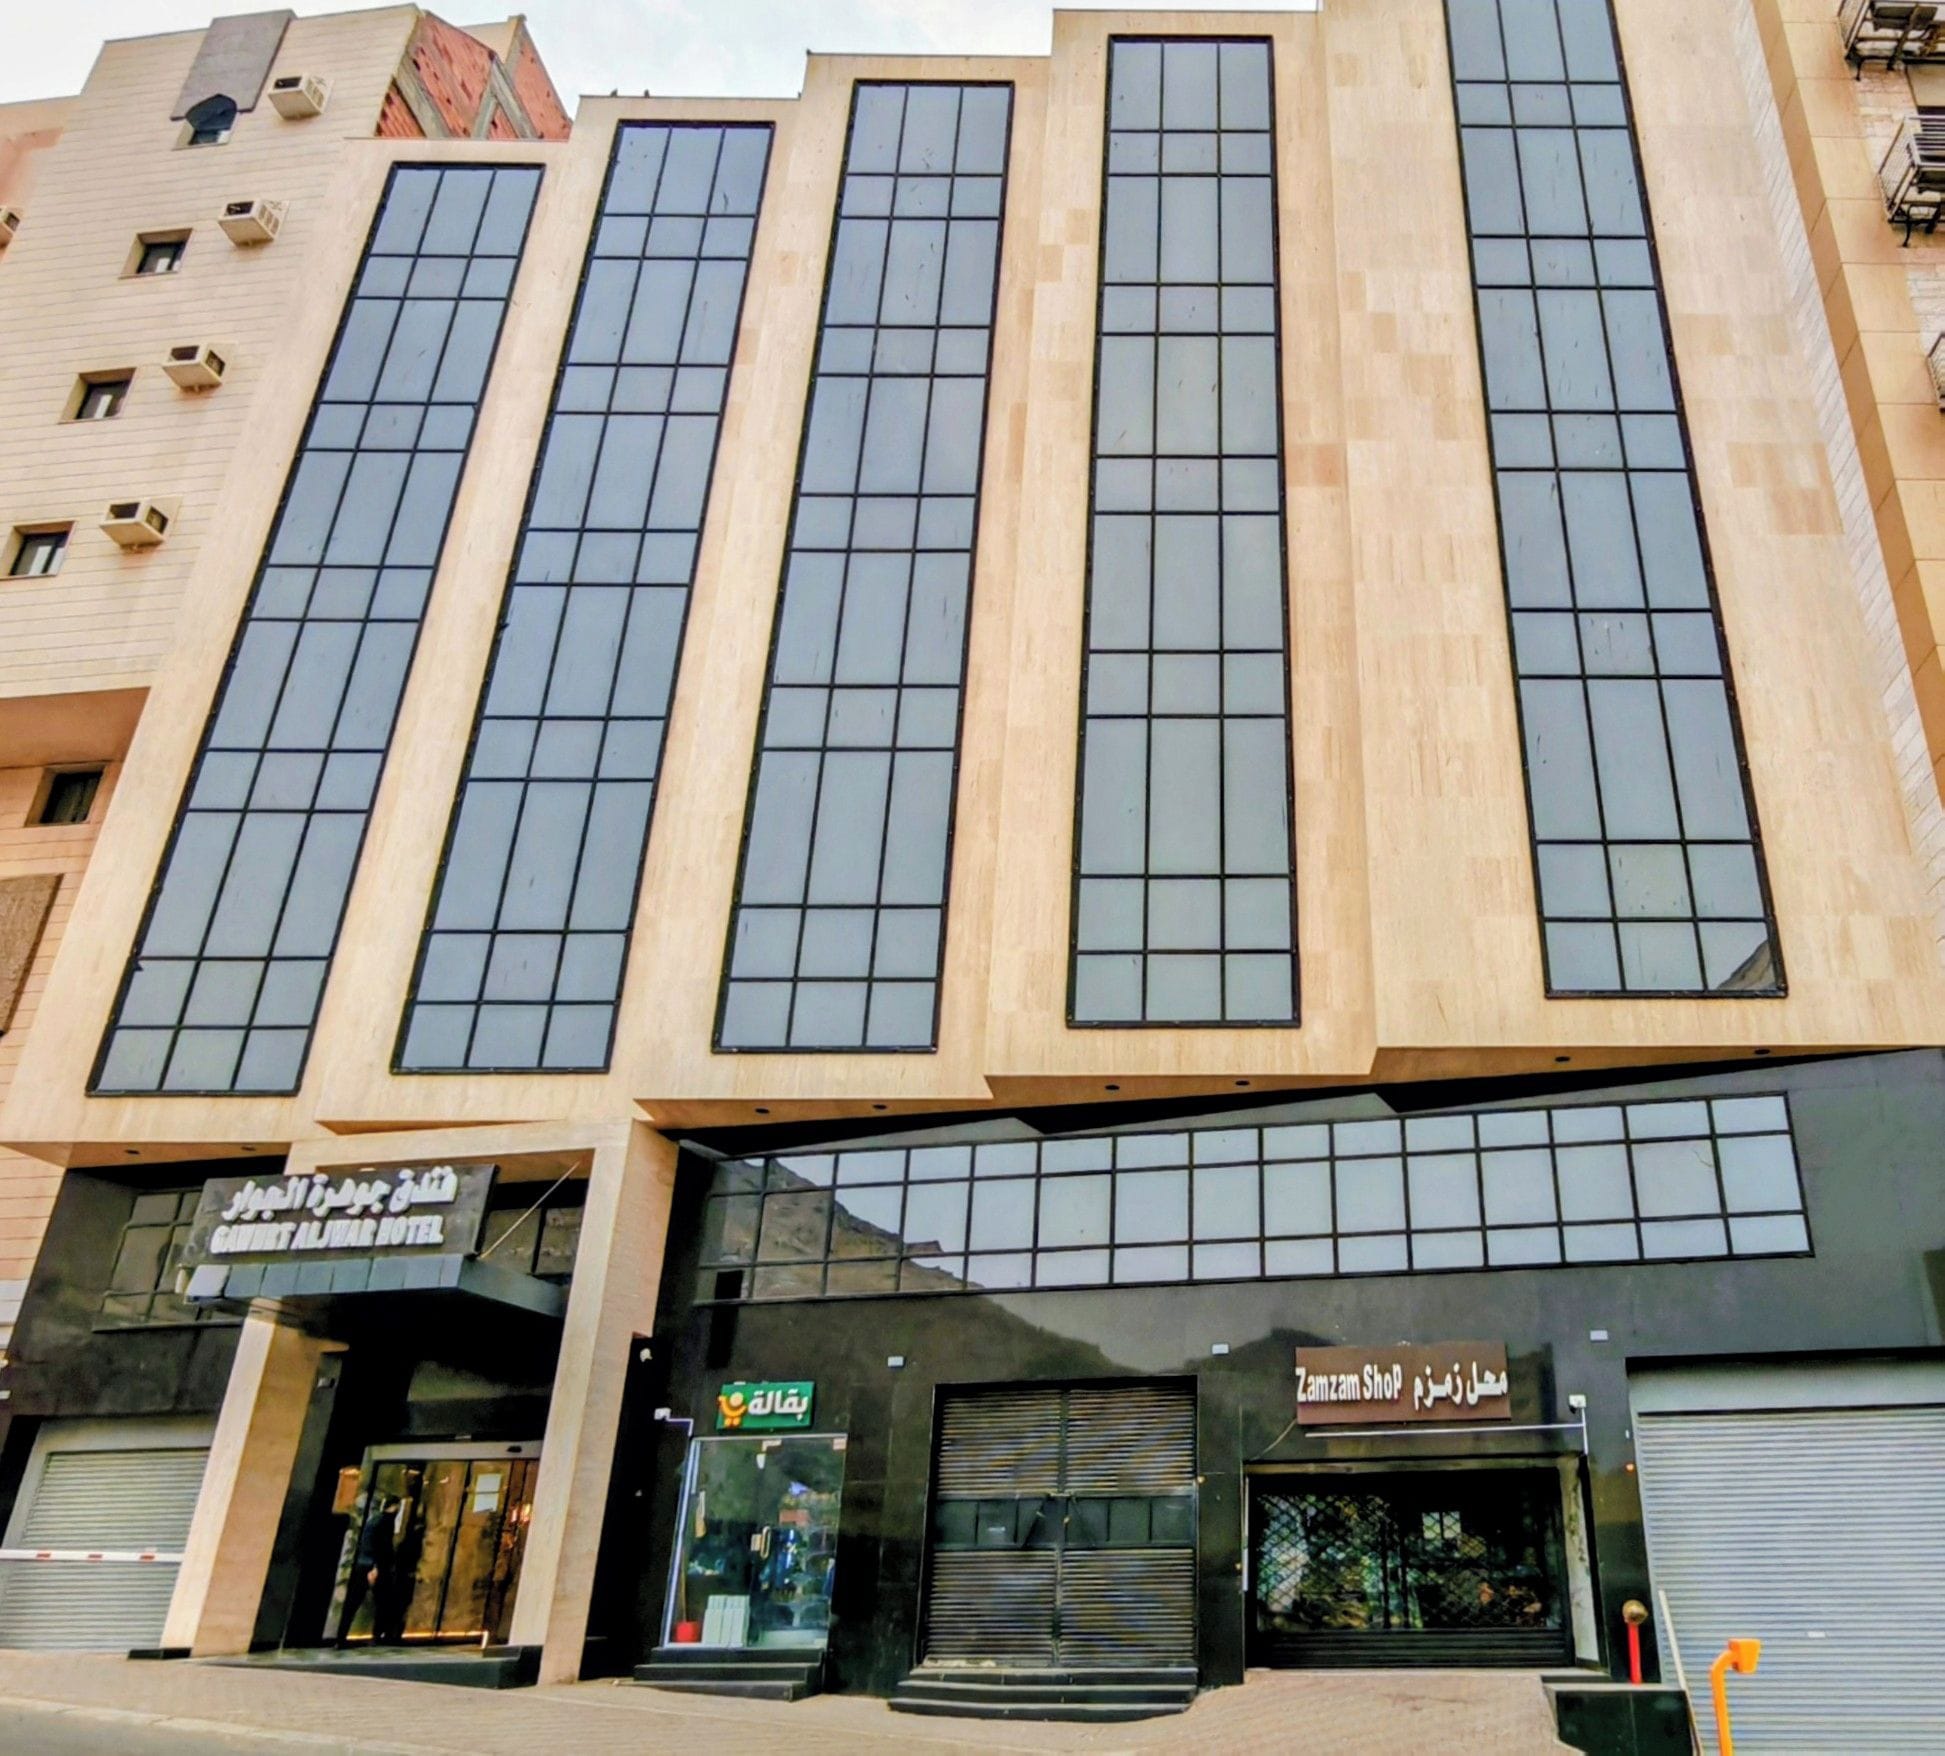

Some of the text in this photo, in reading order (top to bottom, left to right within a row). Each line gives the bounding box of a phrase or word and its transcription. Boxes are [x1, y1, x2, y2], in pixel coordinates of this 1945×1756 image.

[389, 1165, 458, 1213] فندق
[290, 1218, 377, 1250] ALJWAR
[374, 1214, 444, 1246] HOTEL
[1295, 1366, 1361, 1402] Zamzam
[1413, 1361, 1508, 1410] محل زمزم
[748, 1388, 809, 1421] بقالة
